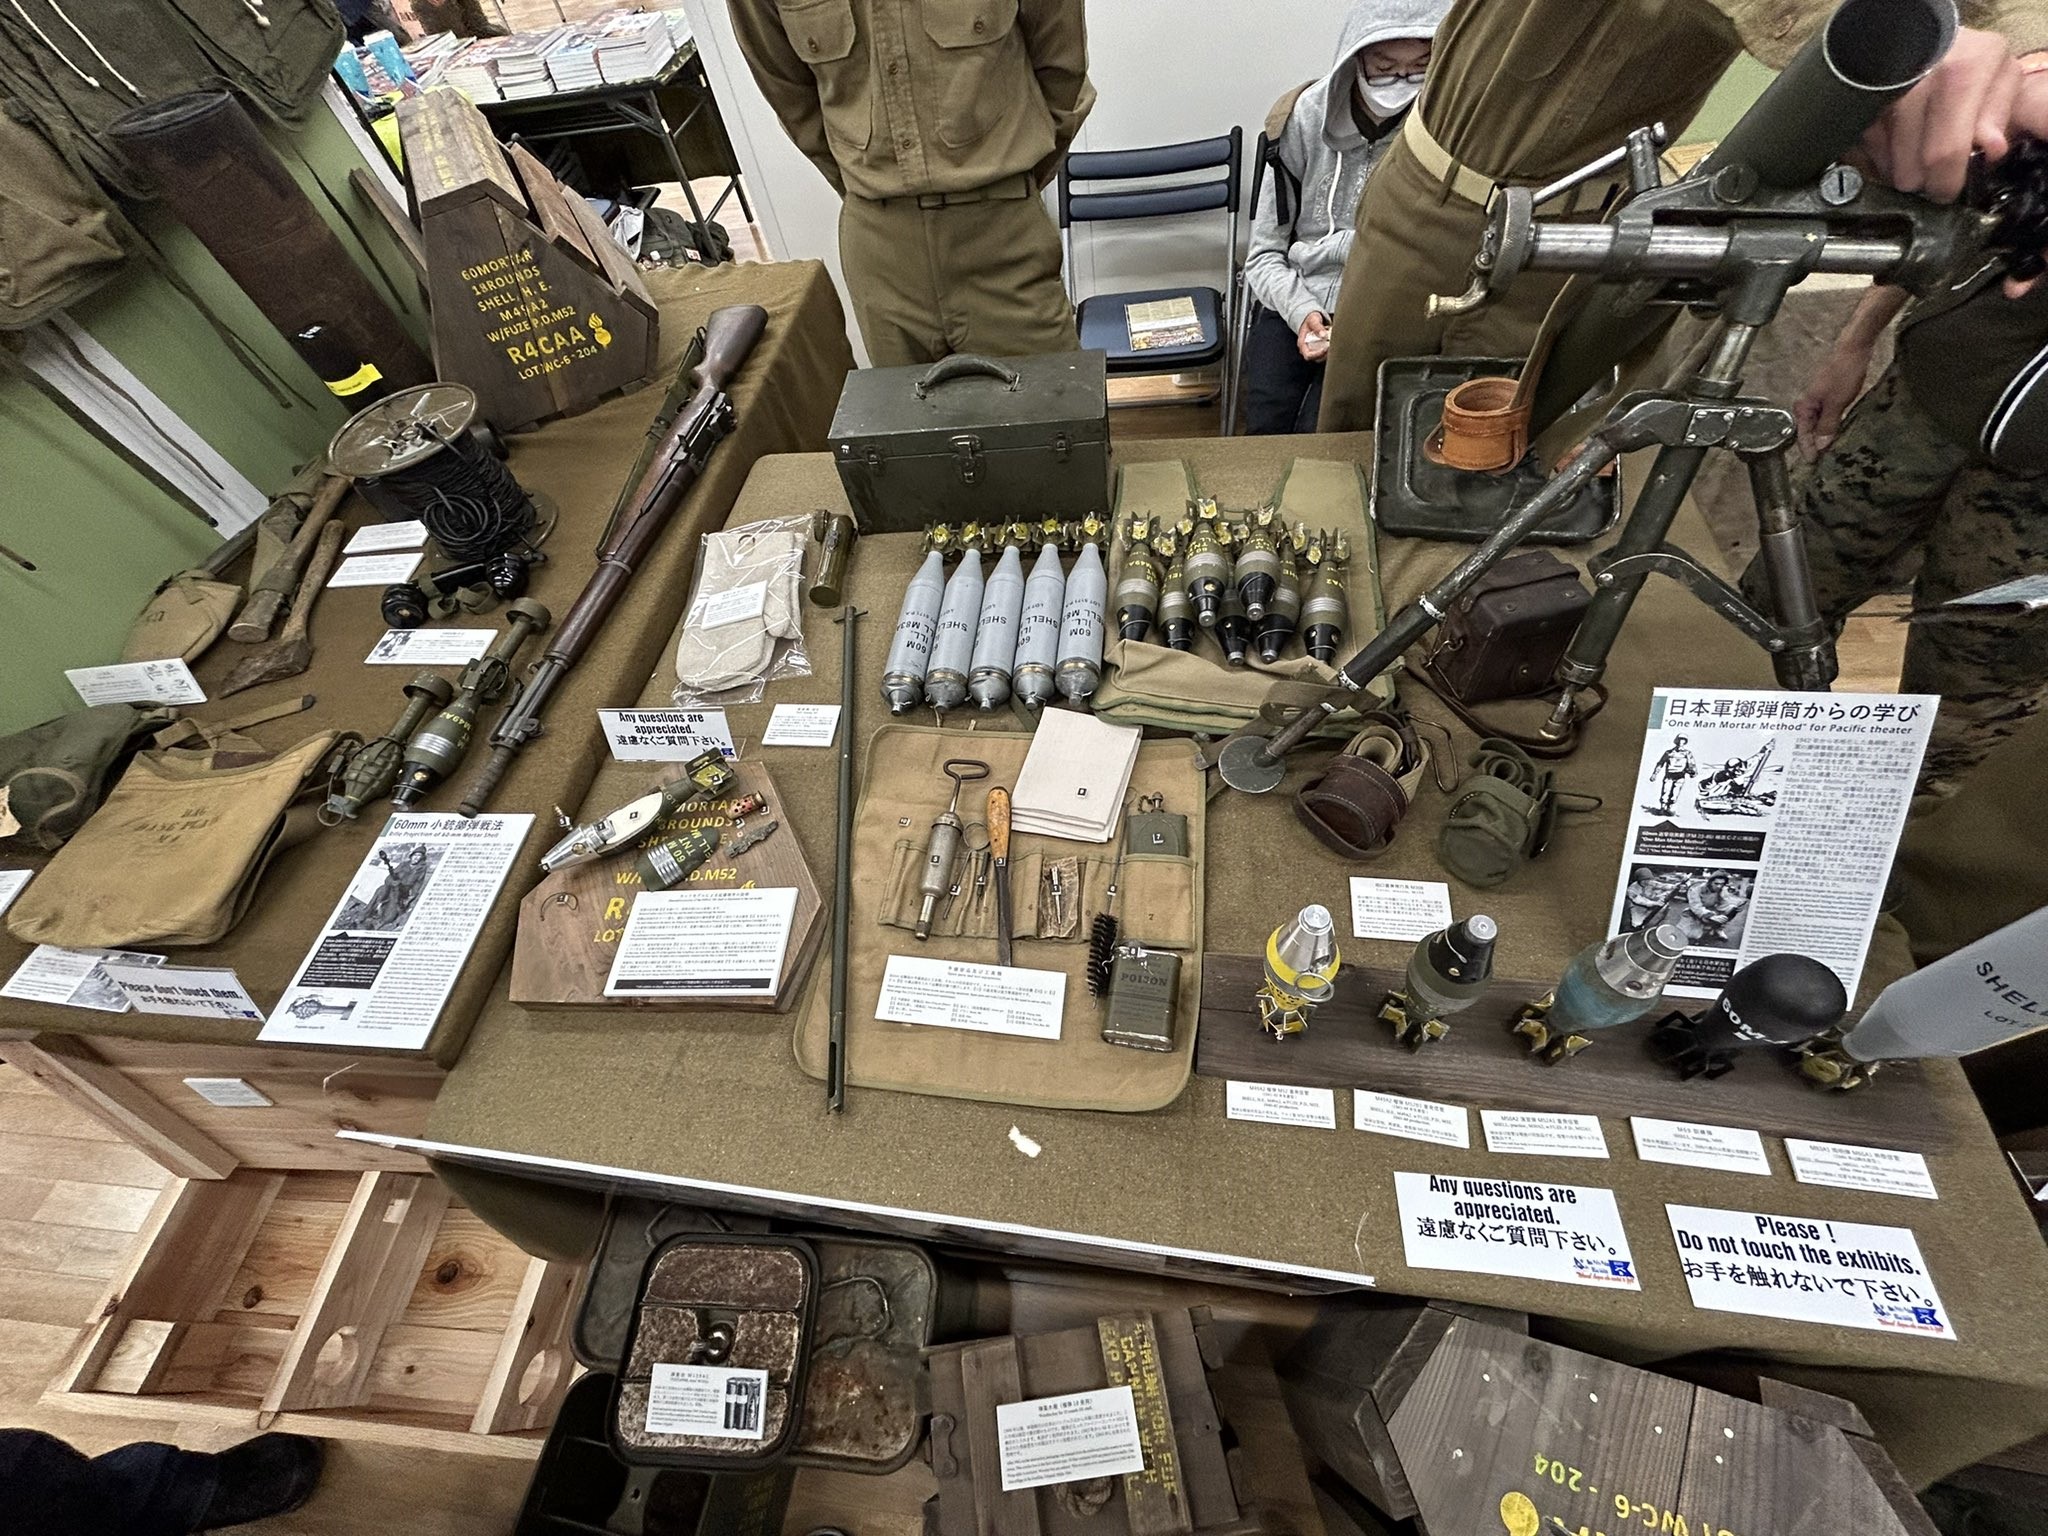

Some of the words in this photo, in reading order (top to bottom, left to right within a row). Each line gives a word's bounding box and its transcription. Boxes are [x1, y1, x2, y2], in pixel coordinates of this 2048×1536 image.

[461, 249, 533, 281] 60MORTAR
[472, 265, 541, 296] 18ROUNDS
[486, 319, 531, 343] W/FUZE
[506, 326, 586, 365] R4CAA
[518, 365, 540, 380] LOT
[1025, 616, 1058, 629] SHELL
[1069, 628, 1091, 637] 60M
[906, 640, 927, 654] 60M
[619, 712, 636, 723] Any
[638, 712, 686, 724] questions
[687, 713, 704, 722] are
[1669, 698, 1921, 723] 日本軍擲弾筒からの学び
[635, 724, 695, 735] appreciated.
[1693, 720, 1715, 729] Man
[1719, 720, 1756, 730] Mortar
[1810, 722, 1825, 732] for
[1829, 723, 1866, 734] Pacific
[1869, 724, 1913, 735] theater
[616, 734, 727, 747] 遠慮なくご質問下さい。
[394, 820, 428, 830] 60mm
[679, 836, 696, 856] TNT
[1121, 972, 1168, 987] POISON
[118, 980, 154, 994] Please
[179, 986, 211, 998] touch
[209, 988, 243, 1000] them.
[1429, 1174, 1457, 1196] Any
[1463, 1180, 1544, 1201] questions
[1549, 1187, 1577, 1204] are
[1454, 1201, 1561, 1225] appreciated.
[1417, 1216, 1617, 1256] 遠慮なくご質問下さい。
[1754, 1215, 1820, 1241] Please
[1826, 1223, 1837, 1243] !
[1677, 1229, 1703, 1250] Do
[1707, 1236, 1740, 1255] not
[1741, 1238, 1797, 1261] touch
[1800, 1244, 1832, 1265] the
[1838, 1250, 1921, 1276] exhibits.
[1684, 1258, 1934, 1308] お手を触れないで下さい。
